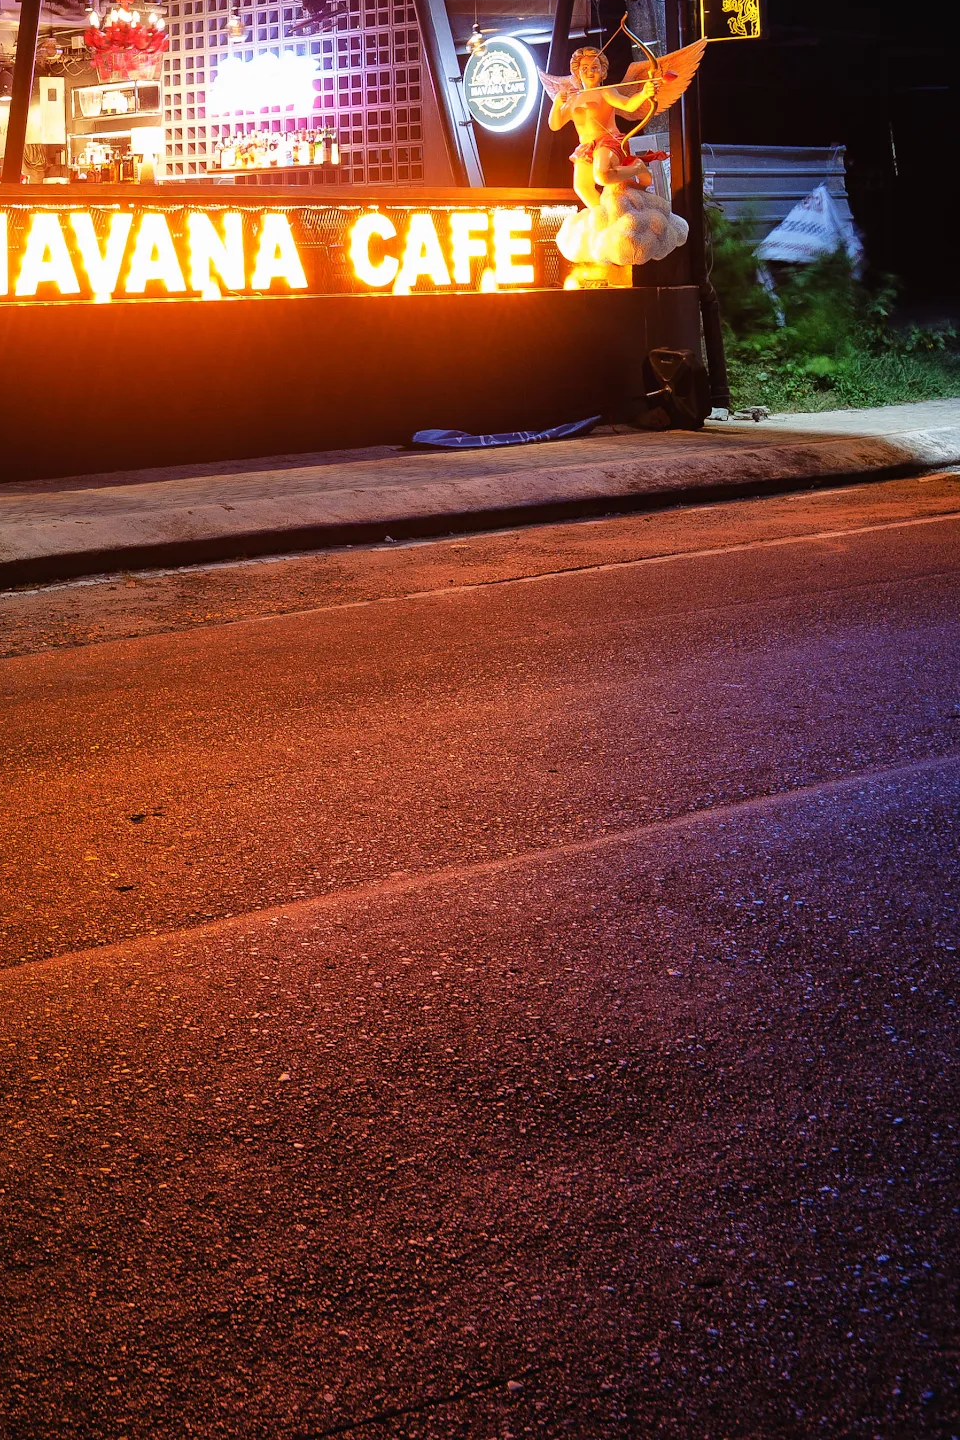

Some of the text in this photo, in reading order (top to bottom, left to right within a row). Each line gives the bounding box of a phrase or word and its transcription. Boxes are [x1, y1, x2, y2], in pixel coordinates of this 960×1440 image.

[470, 82, 525, 97] HAVANA CAFE
[349, 209, 535, 290] CAFE
